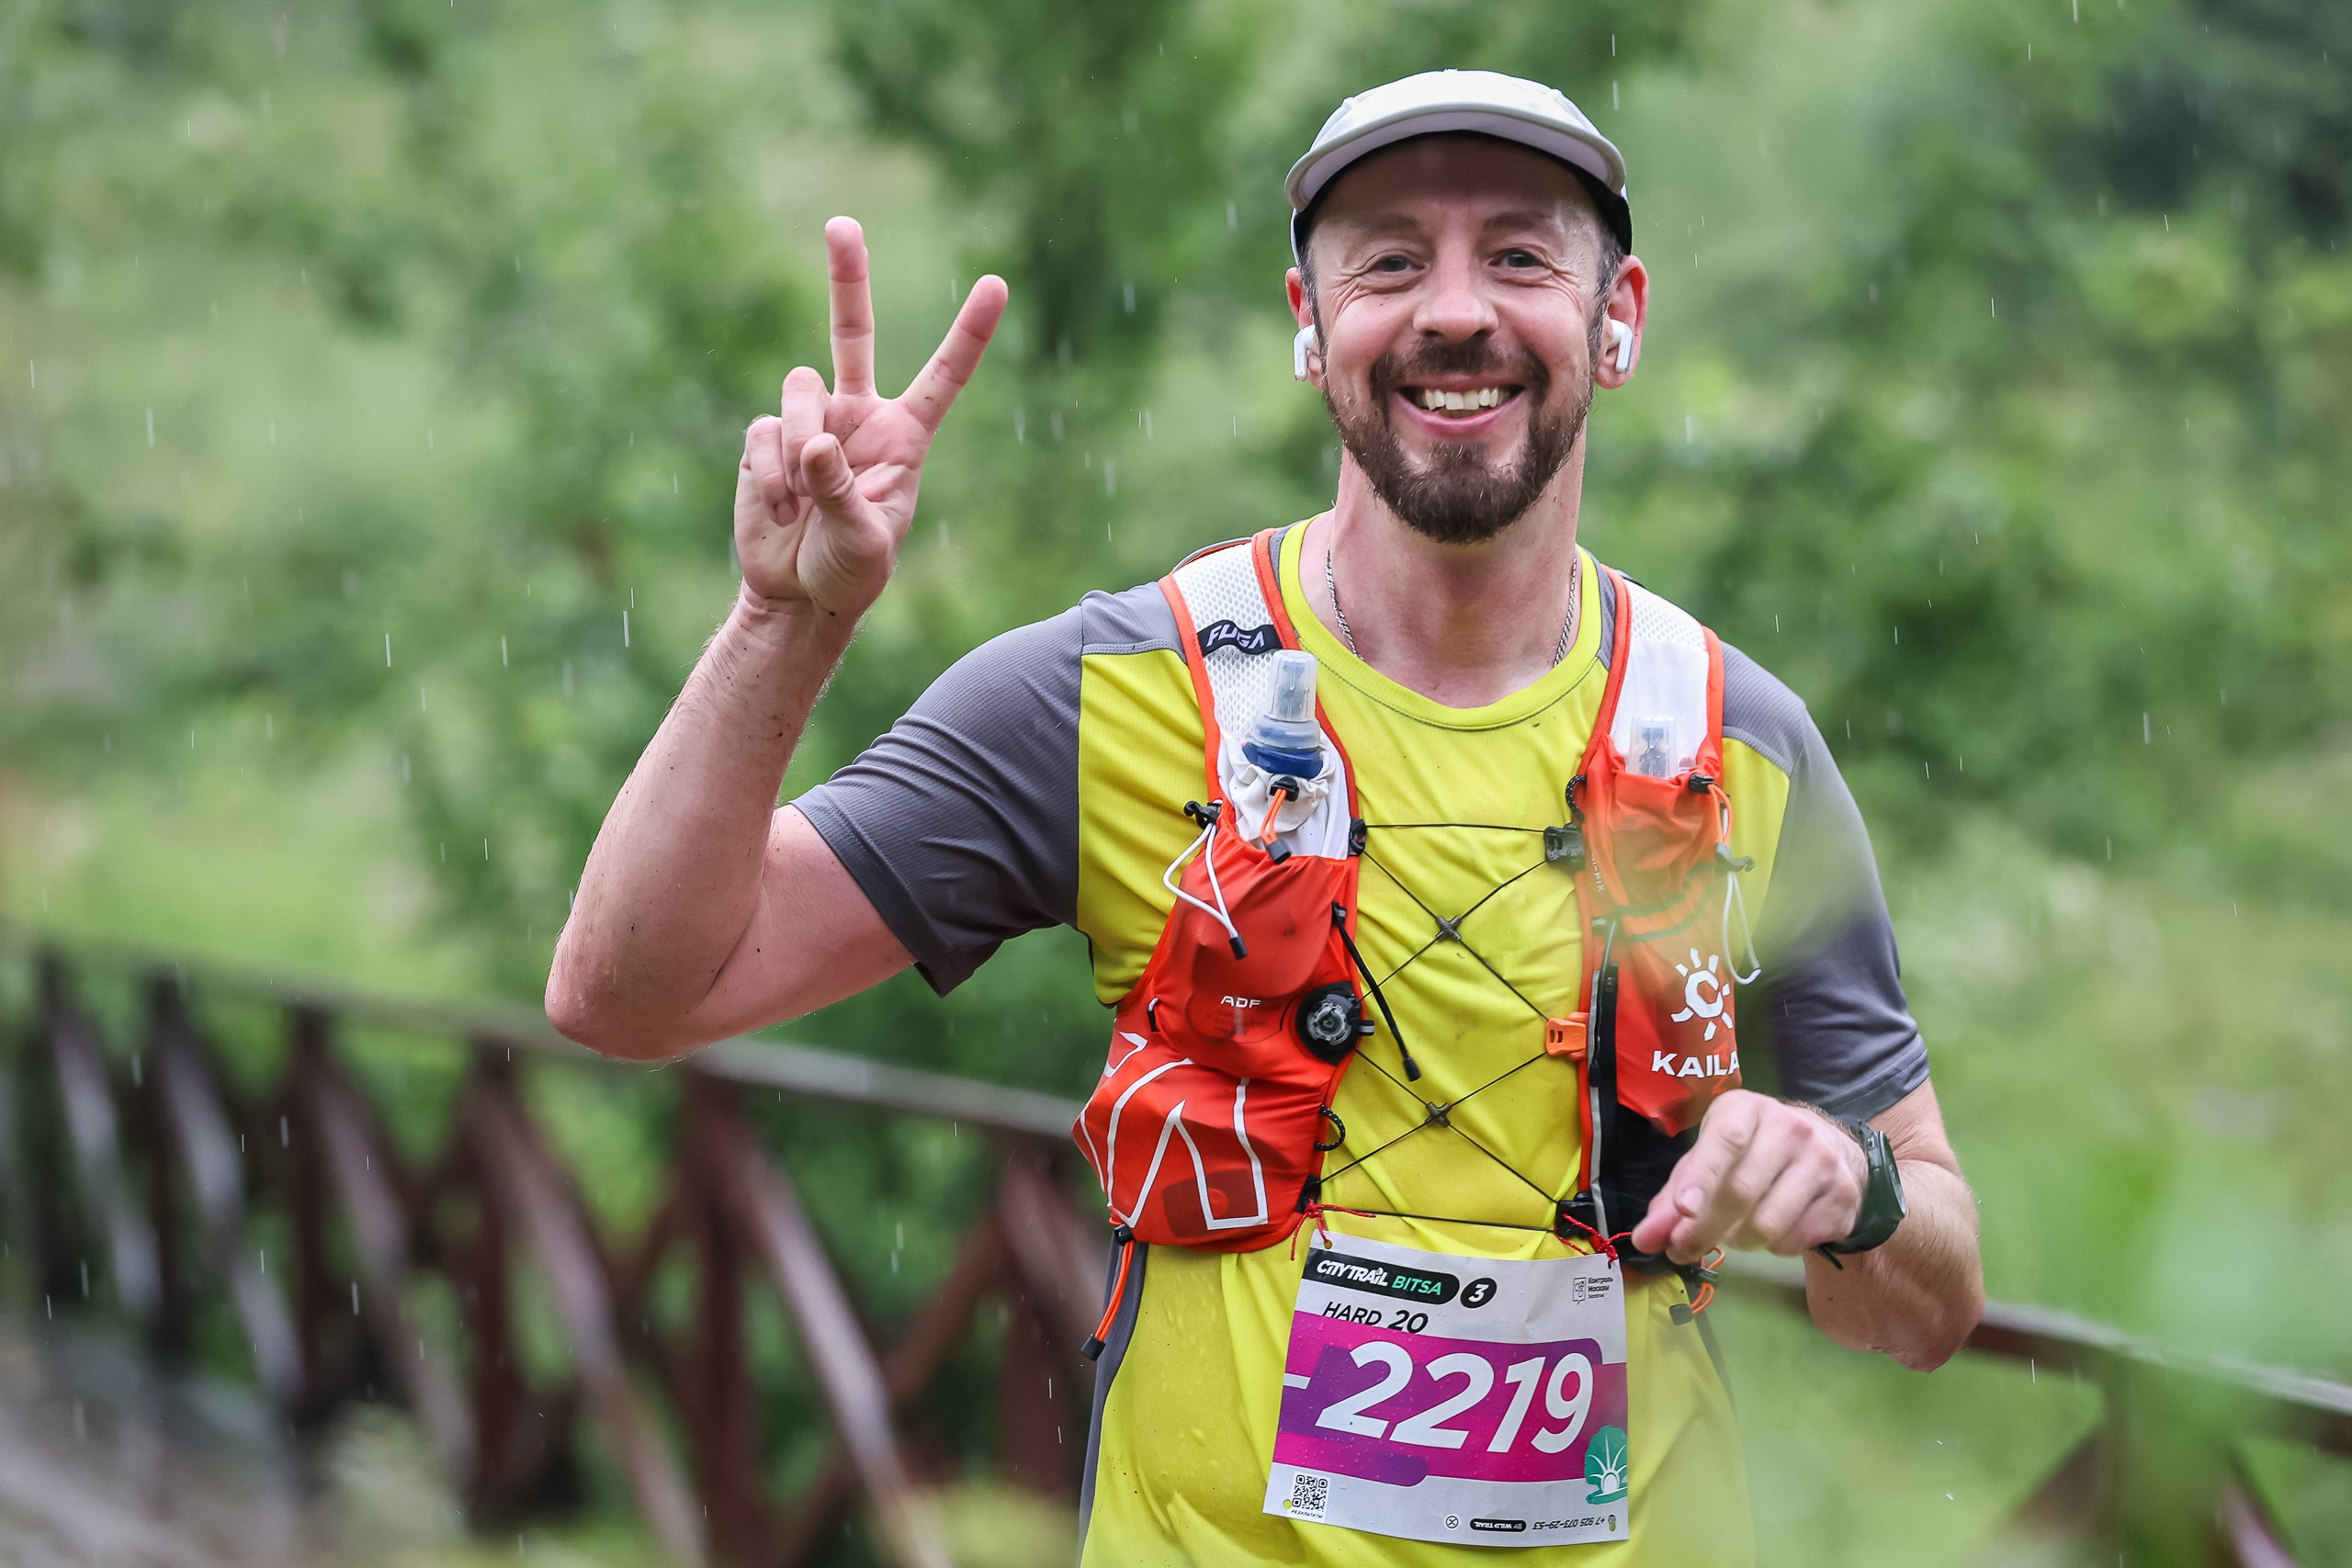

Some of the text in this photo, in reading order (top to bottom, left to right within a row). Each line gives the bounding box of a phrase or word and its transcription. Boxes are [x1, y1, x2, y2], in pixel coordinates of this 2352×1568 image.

[1220, 995, 1261, 1009] ADF
[1651, 1050, 1741, 1078] KAILA
[1392, 1275, 1442, 1296] BITSA
[1468, 1284, 1490, 1303] 3
[1322, 1301, 1430, 1335] HARD 20
[1315, 1340, 1594, 1454] 2219
[1532, 1517, 1605, 1530] +7 925 073-29-53
